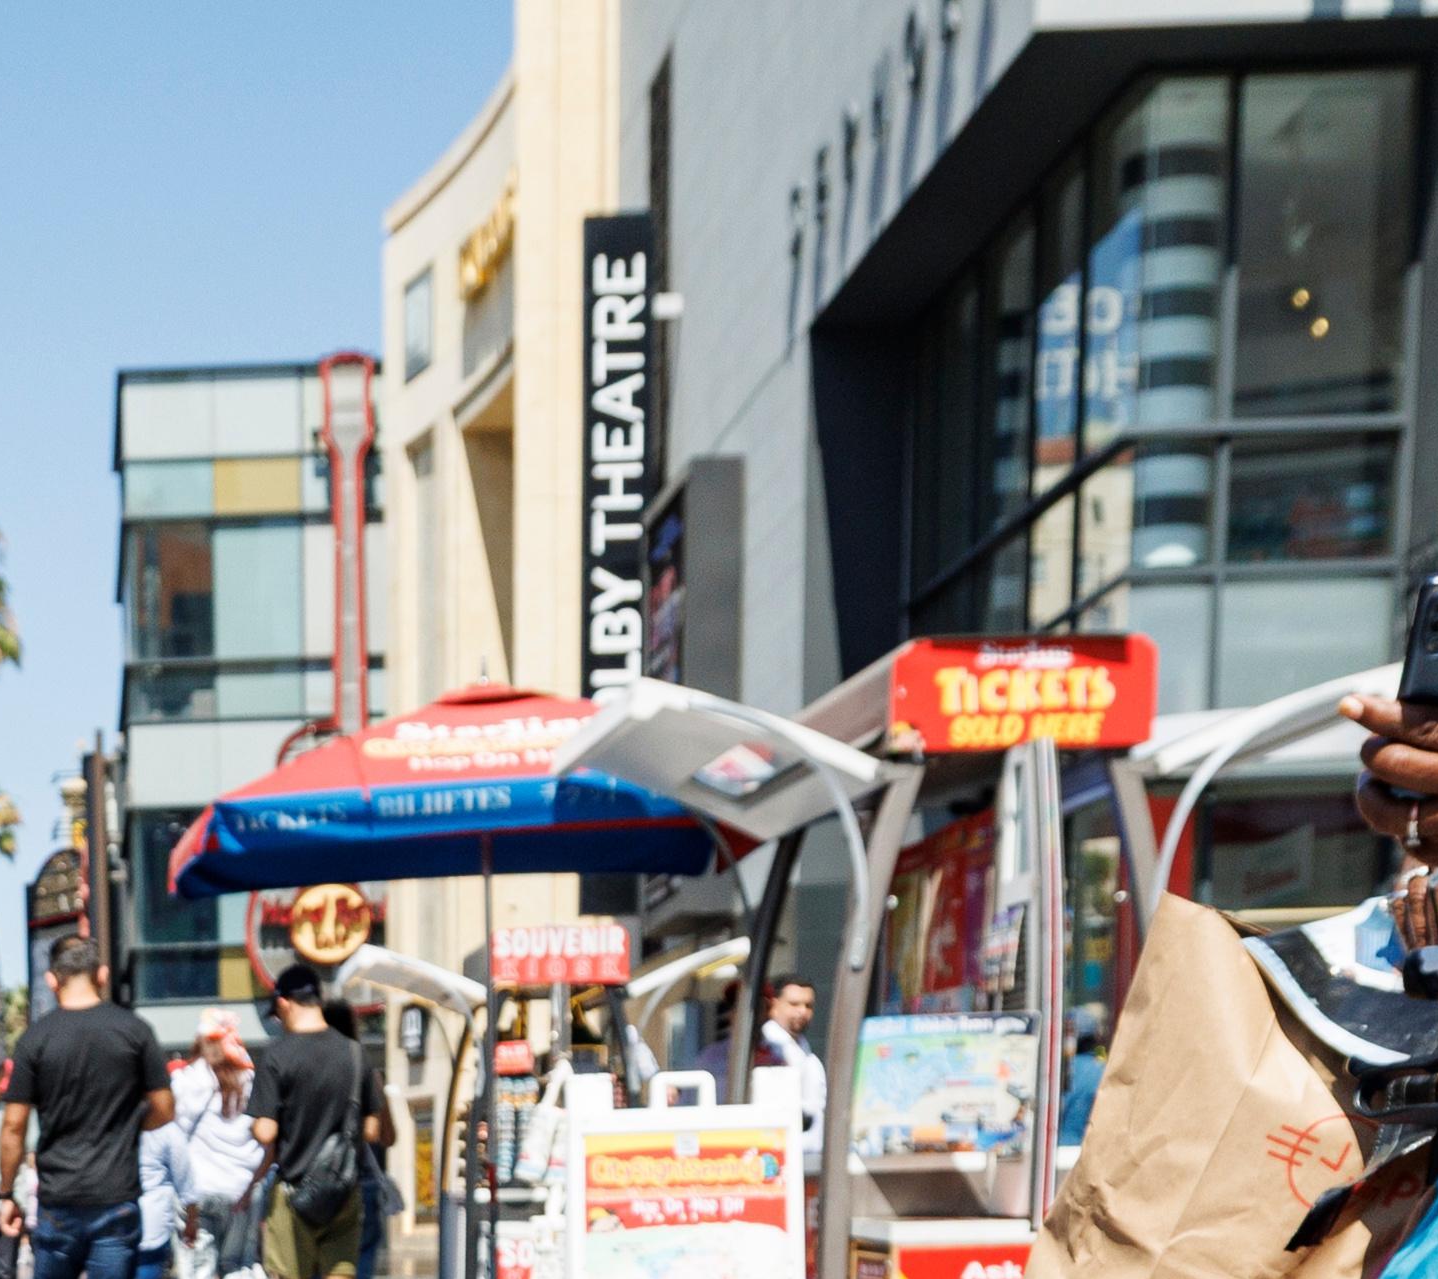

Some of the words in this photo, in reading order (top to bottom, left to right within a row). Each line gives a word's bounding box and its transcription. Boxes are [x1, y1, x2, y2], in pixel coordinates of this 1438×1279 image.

[591, 250, 646, 556] THEATRE
[590, 566, 643, 705] LBY
[948, 712, 1023, 747] SOLD
[1028, 711, 1105, 744] HERE
[494, 926, 625, 957] SOUVENIR
[498, 957, 621, 978] KIOSK
